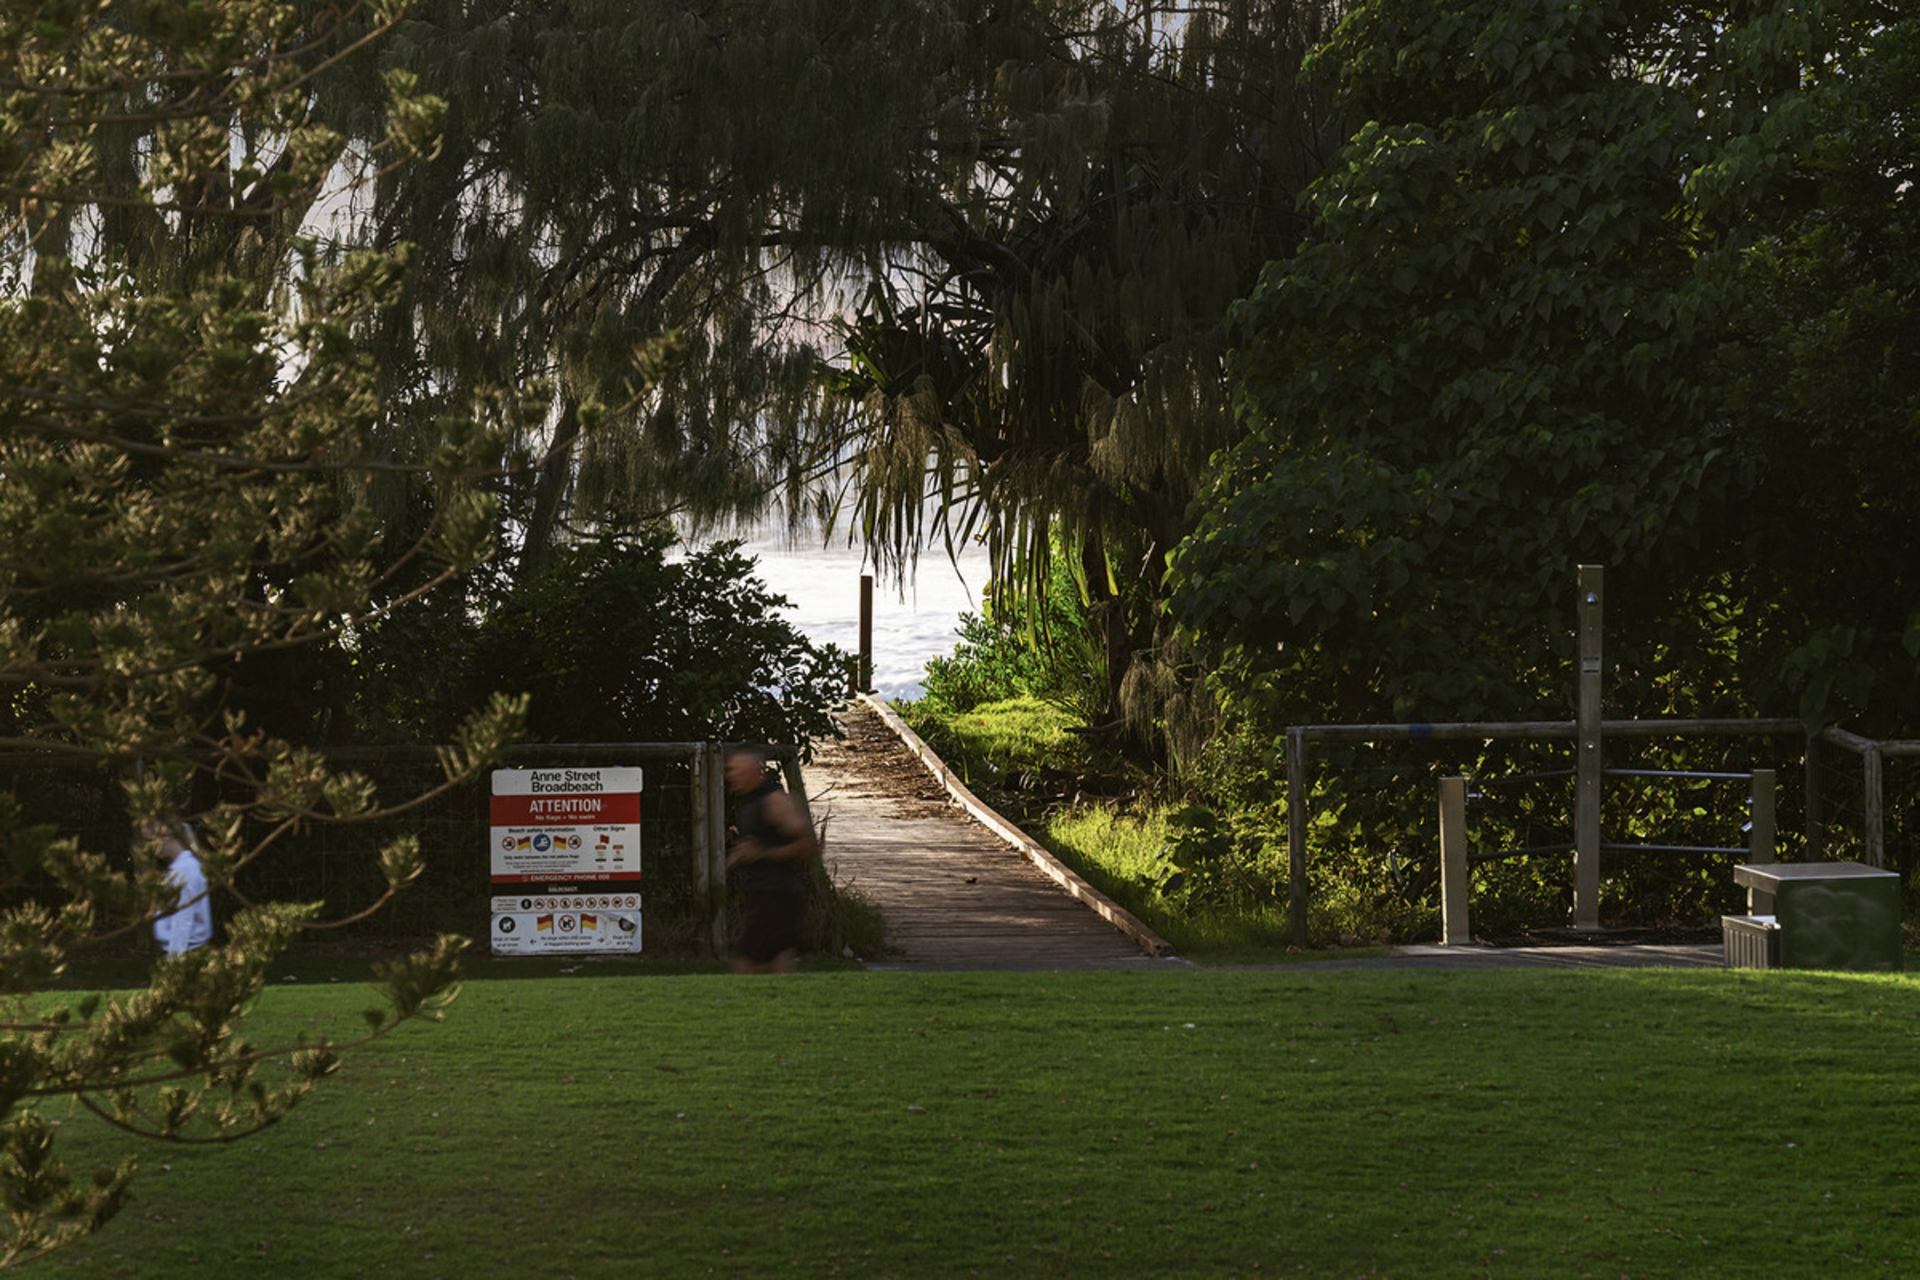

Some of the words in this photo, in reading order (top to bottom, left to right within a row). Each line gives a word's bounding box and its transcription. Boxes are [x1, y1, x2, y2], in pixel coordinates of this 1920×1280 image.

[530, 771, 561, 781] Anne
[565, 770, 601, 781] Street
[532, 781, 603, 792] Broadbeach
[529, 799, 601, 812] ATTENTION
